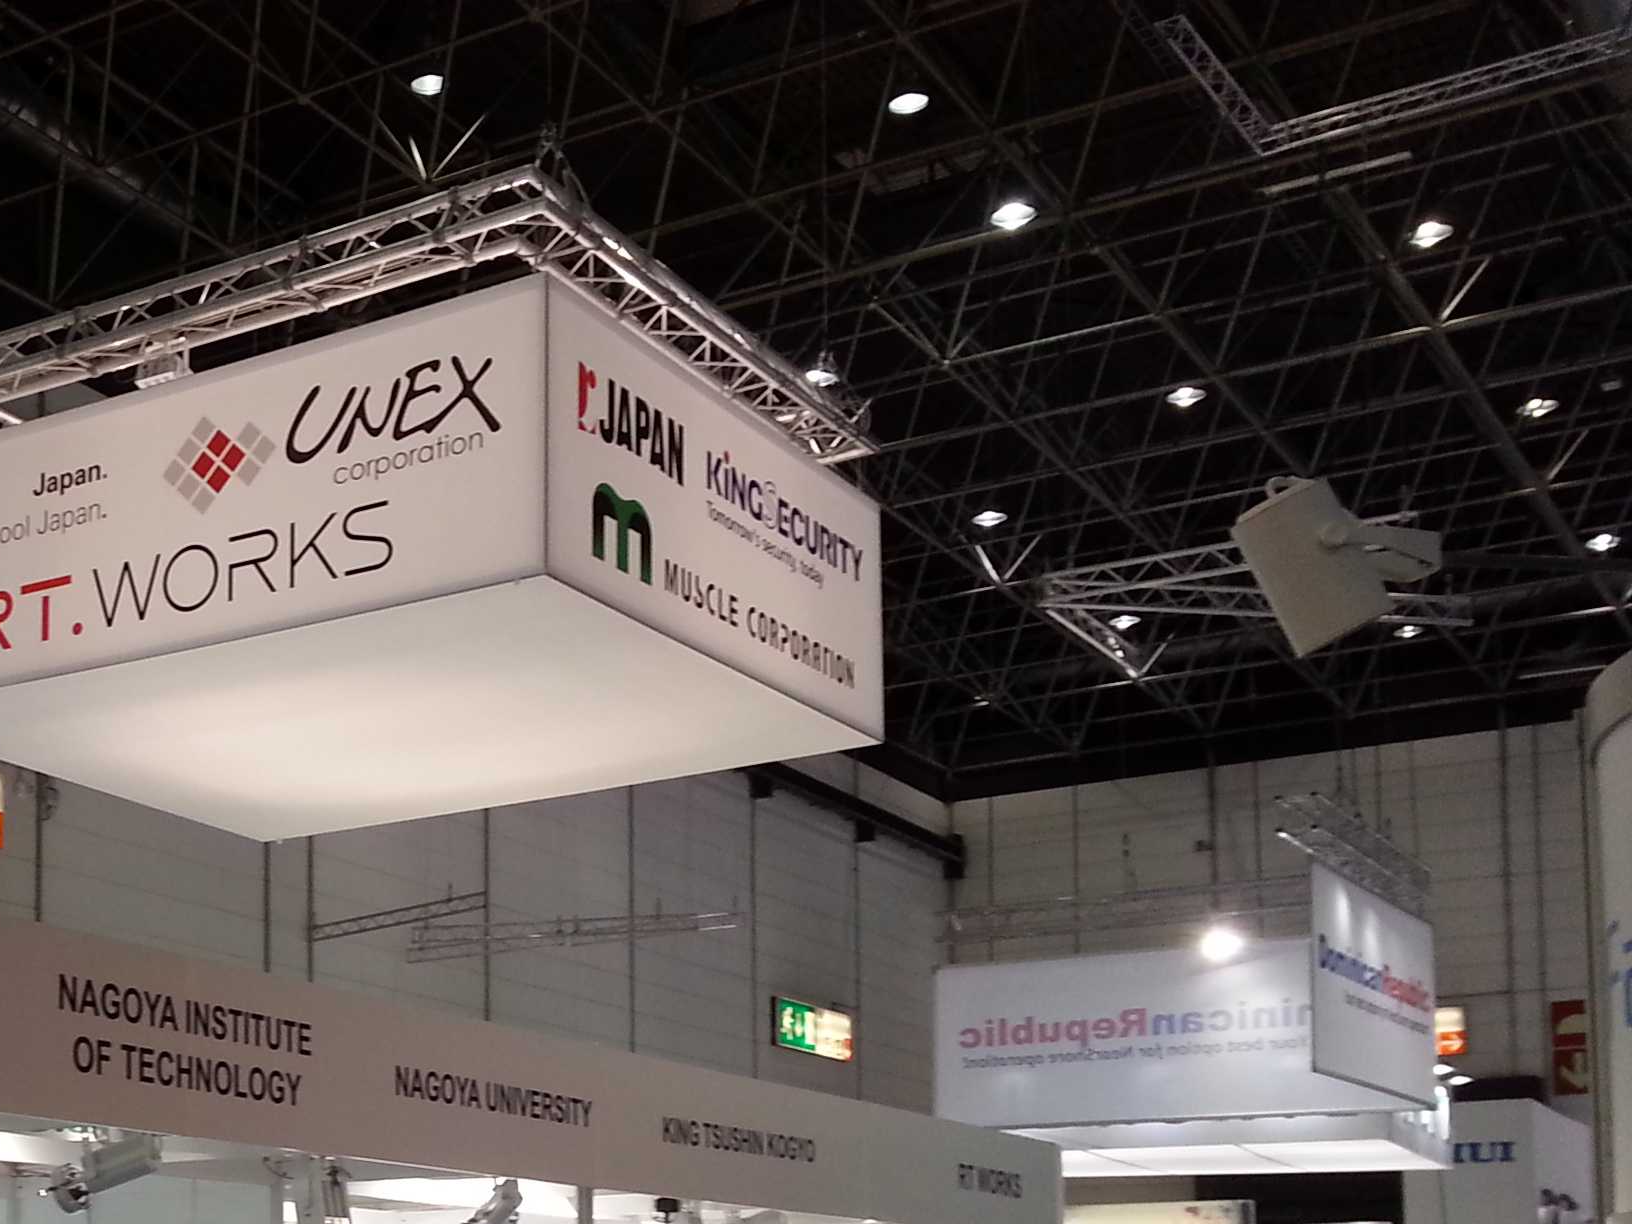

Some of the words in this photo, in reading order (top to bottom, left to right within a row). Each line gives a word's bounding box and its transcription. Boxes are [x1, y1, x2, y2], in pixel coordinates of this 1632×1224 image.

[286, 356, 501, 463] UNEX
[32, 463, 107, 496] Japan.
[333, 432, 483, 484] corporation
[37, 502, 107, 537] Japan.
[665, 559, 739, 628] MUSCLE
[746, 606, 856, 689] CORPORATION
[58, 973, 178, 1032] NAGOYA
[185, 999, 313, 1057] INSTITUTE
[72, 1037, 111, 1075] OF
[120, 1043, 303, 1106] TECHNOLOGY
[394, 1065, 482, 1110] NAGOYA
[486, 1081, 593, 1129] UNIVERSITY
[663, 1116, 699, 1146] KING
[703, 1122, 764, 1155] TSUSHIN
[767, 1133, 816, 1163] KOGYO
[958, 1163, 974, 1191] RT
[977, 1166, 1023, 1199] WORKS
